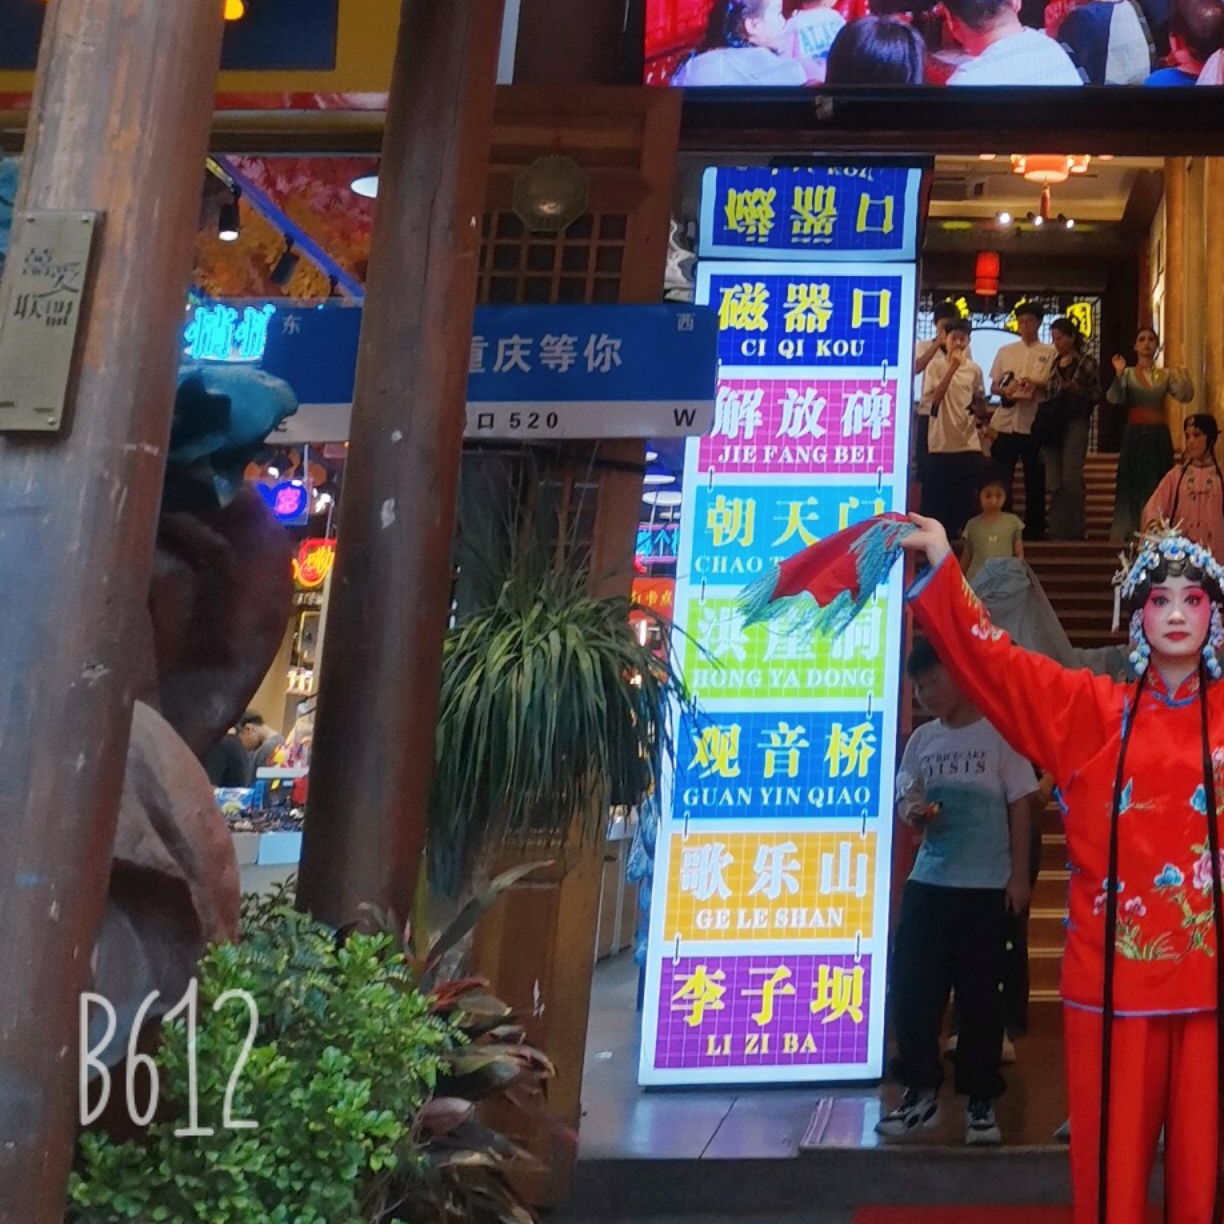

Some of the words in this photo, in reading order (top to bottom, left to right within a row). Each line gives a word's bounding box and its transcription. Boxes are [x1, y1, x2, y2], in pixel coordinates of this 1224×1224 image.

[717, 281, 892, 333] 磁器口
[282, 313, 301, 335] 东
[676, 312, 695, 332] 西
[741, 339, 766, 357] CI
[777, 339, 804, 360] QI
[816, 339, 866, 357] KOU
[509, 411, 559, 429] 520
[673, 407, 697, 427] W
[710, 384, 894, 441] 解放碑
[717, 445, 757, 465] JIE
[763, 445, 828, 464] FANG
[832, 445, 876, 464] BEI
[694, 555, 763, 574] CHAO
[692, 668, 763, 689] HONG
[768, 668, 799, 688] YA
[806, 668, 875, 688] DONG
[687, 721, 878, 779] 观音桥
[683, 786, 751, 807] GUAN
[760, 786, 801, 807] YIN
[807, 786, 871, 808] QIAO
[681, 841, 869, 901] 歌乐山
[696, 908, 731, 929] GE
[736, 908, 768, 928] LE
[775, 907, 845, 928] SHAN
[671, 962, 866, 1027] 李子坝
[707, 1034, 731, 1056] LI
[745, 1034, 770, 1055] ZI
[783, 1032, 818, 1055] BA
